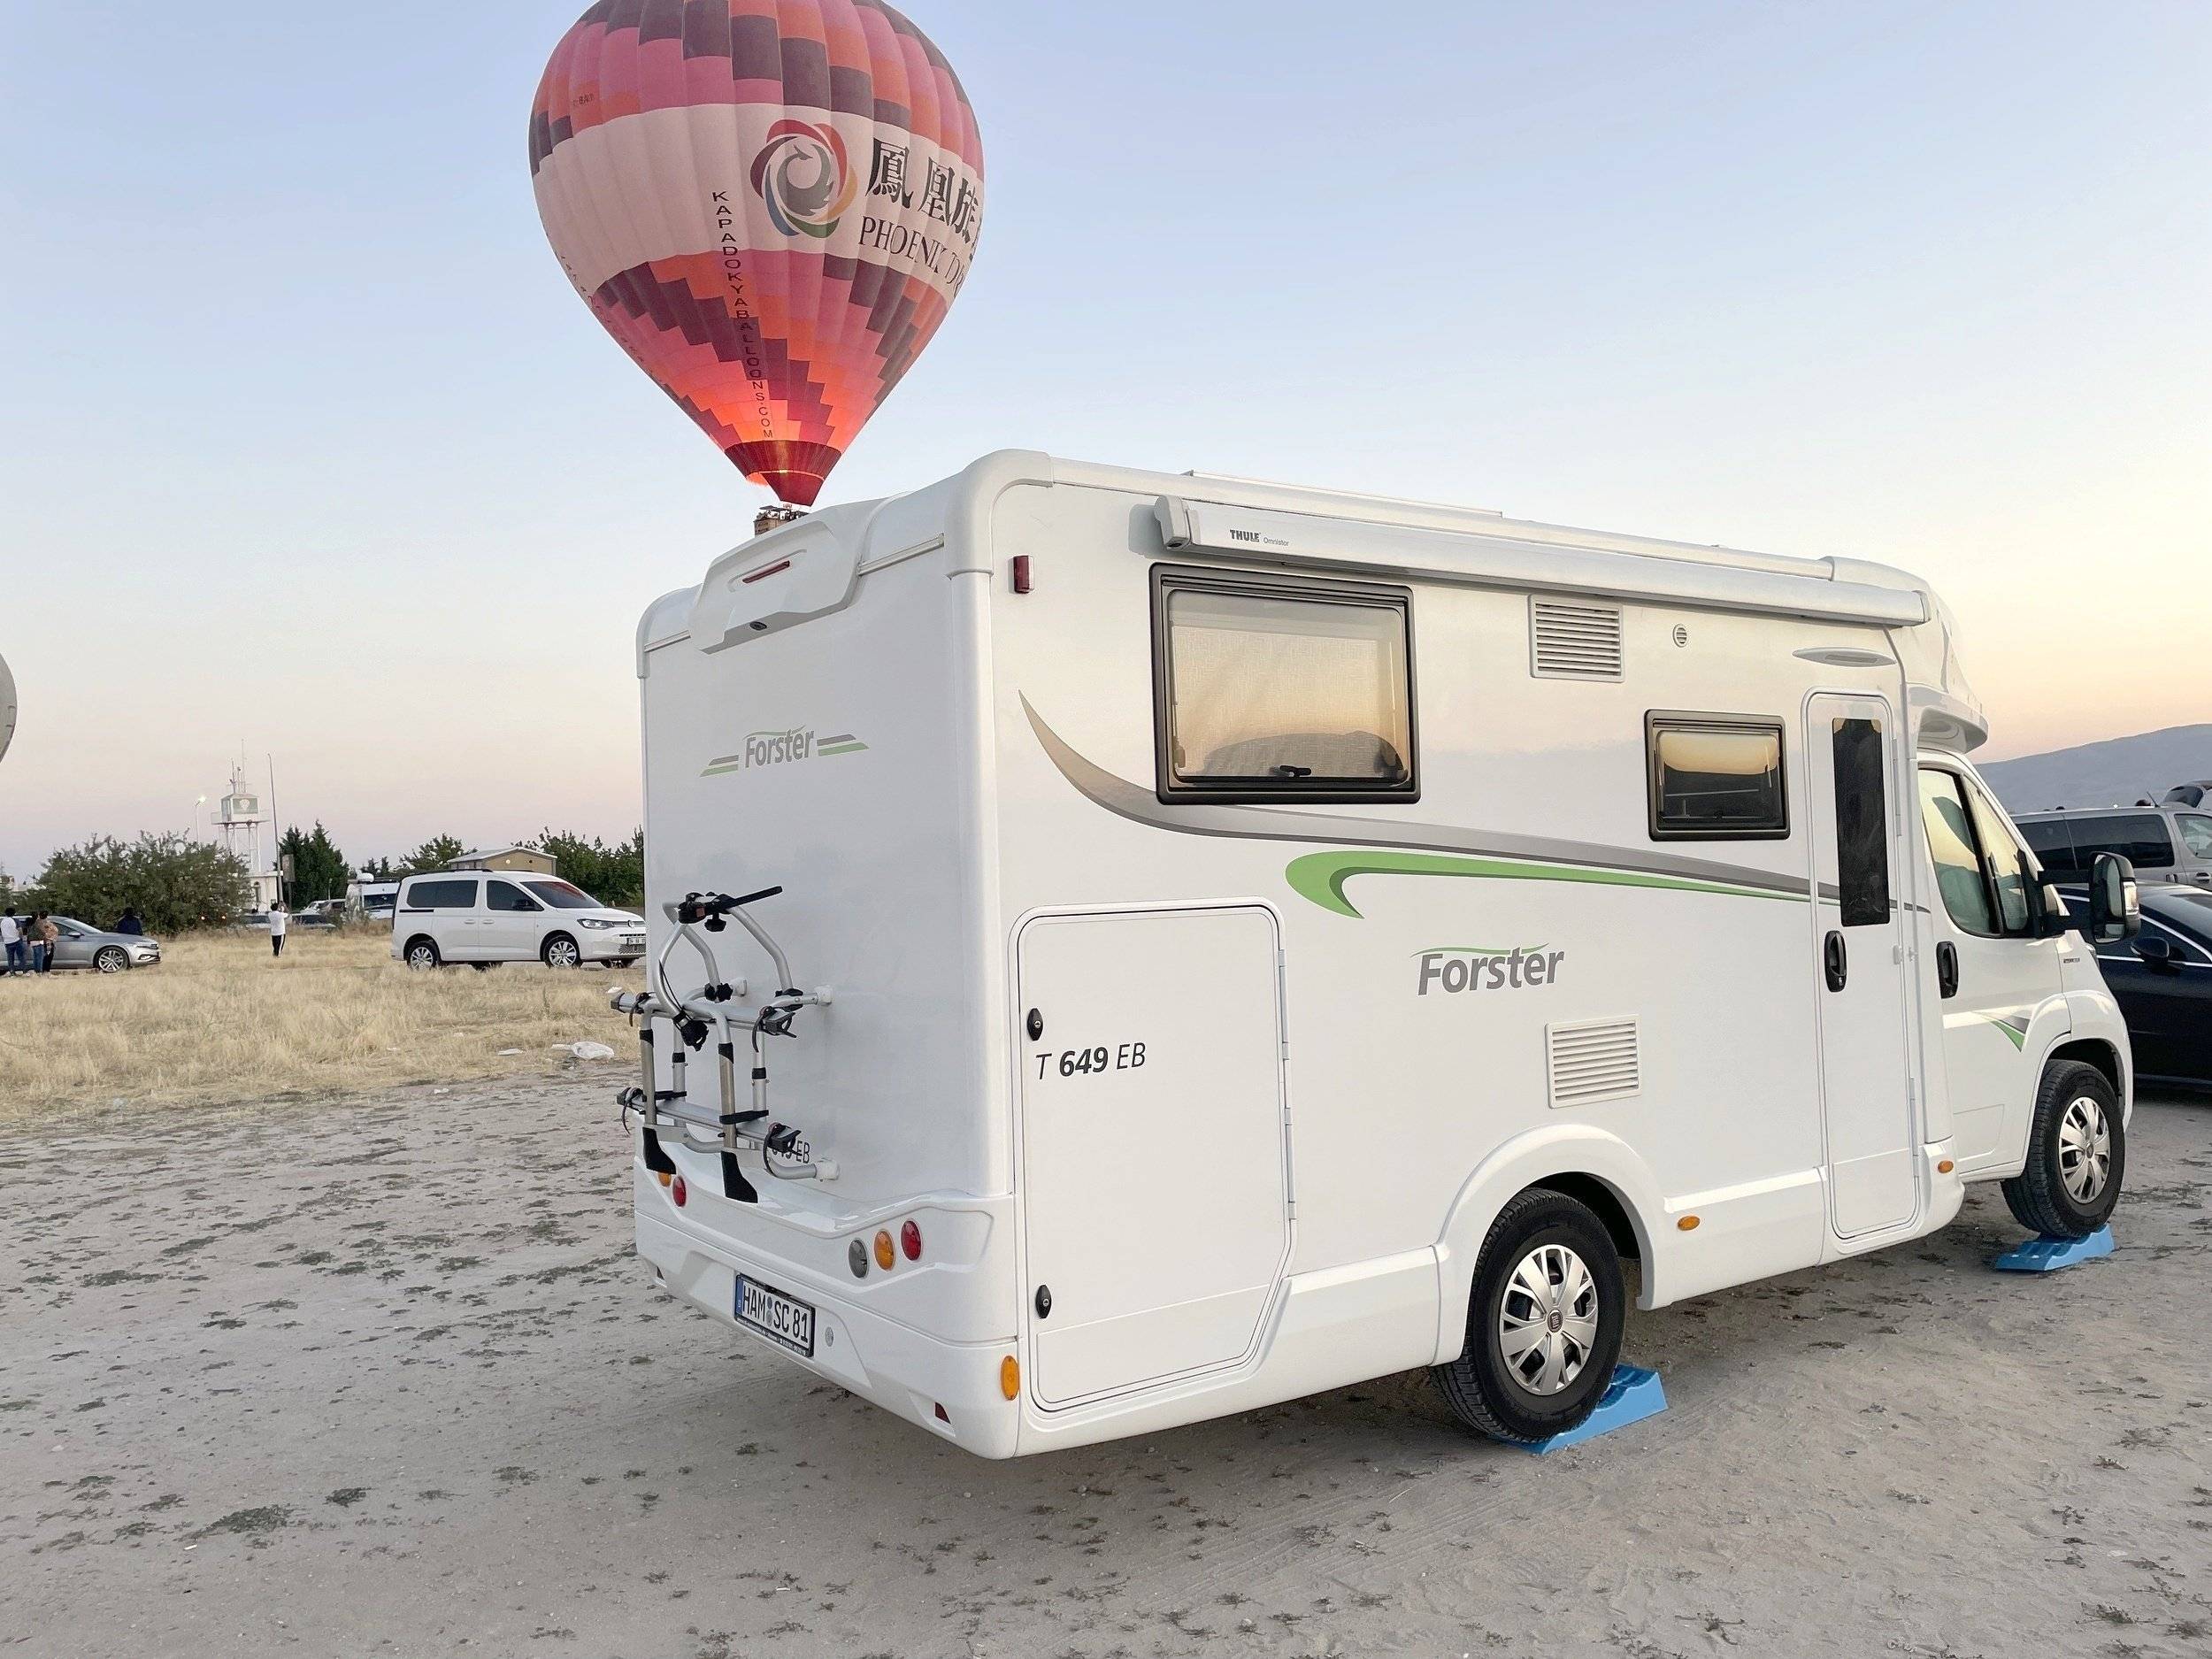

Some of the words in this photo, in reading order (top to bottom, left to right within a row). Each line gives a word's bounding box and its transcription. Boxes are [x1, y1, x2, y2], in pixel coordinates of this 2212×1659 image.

[865, 137, 980, 259] 鳳凰旅
[711, 190, 774, 439] KAPADOKYABALLOONS.COM
[1229, 528, 1260, 543] THULE
[745, 728, 815, 769] Forster
[1417, 946, 1565, 996] Forster
[1035, 1052, 1053, 1080] T
[1059, 1046, 1110, 1078] 649
[1116, 1041, 1147, 1071] EB
[795, 1140, 810, 1164] EB
[743, 1285, 766, 1323] HAM
[773, 1300, 790, 1333] SC
[792, 1308, 809, 1344] 81
